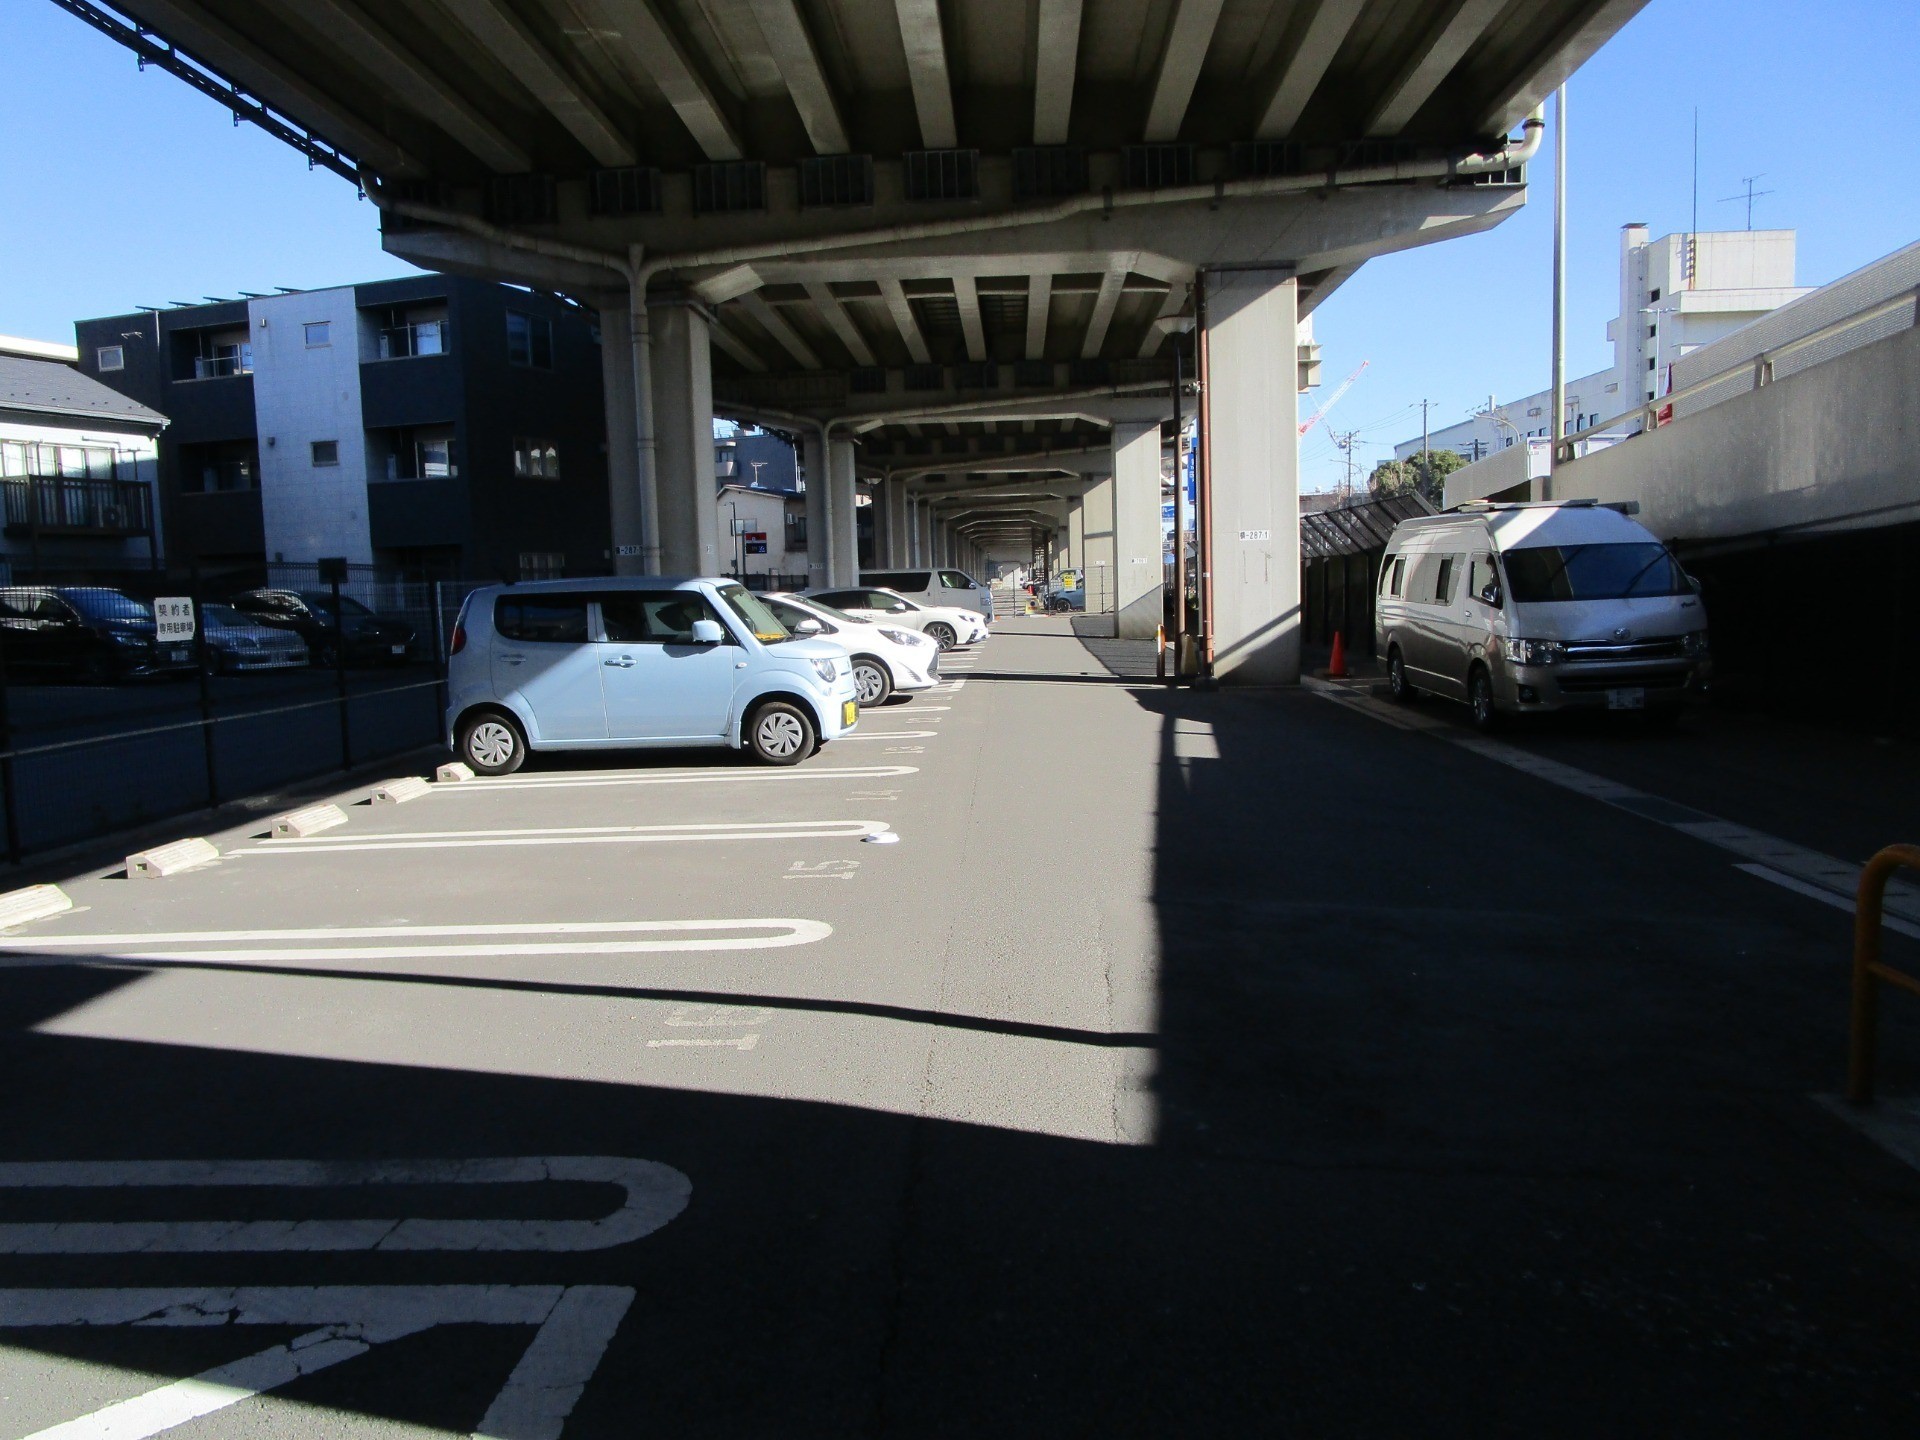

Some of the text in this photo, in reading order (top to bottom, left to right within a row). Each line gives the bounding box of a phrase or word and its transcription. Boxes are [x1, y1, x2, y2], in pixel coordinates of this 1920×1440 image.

[158, 604, 190, 617] 契約者
[159, 621, 193, 634] 専用駐車場
